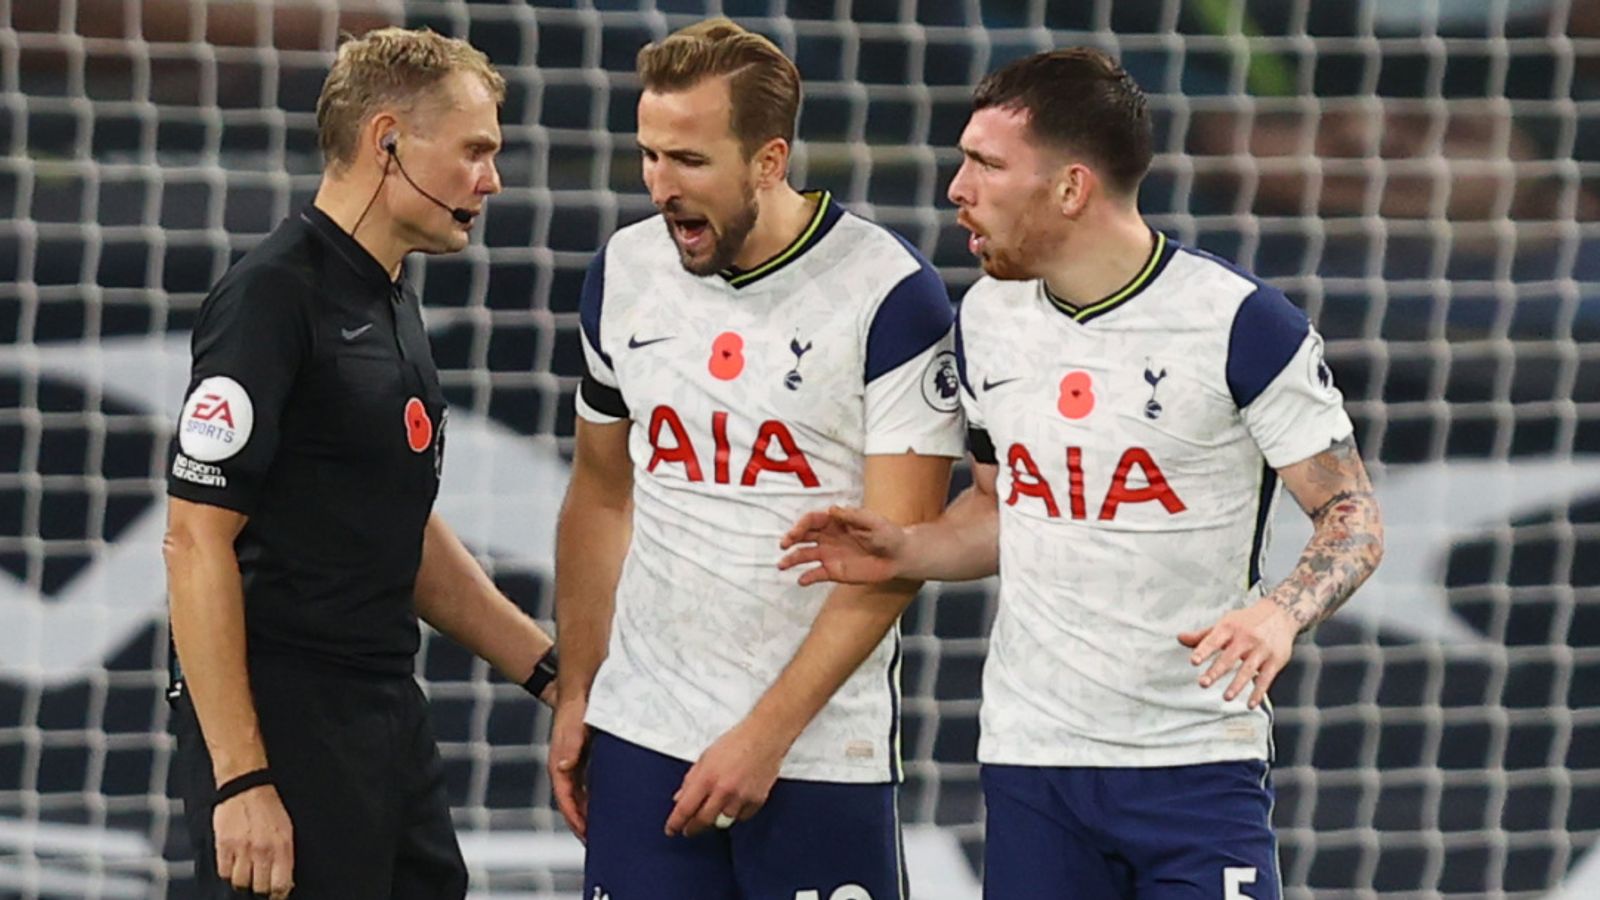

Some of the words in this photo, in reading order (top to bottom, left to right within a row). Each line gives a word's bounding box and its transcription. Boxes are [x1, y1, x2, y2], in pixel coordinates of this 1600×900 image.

[186, 420, 235, 443] SPORTS
[192, 393, 235, 429] EA
[646, 405, 822, 488] AIA
[1005, 443, 1188, 520] AIA
